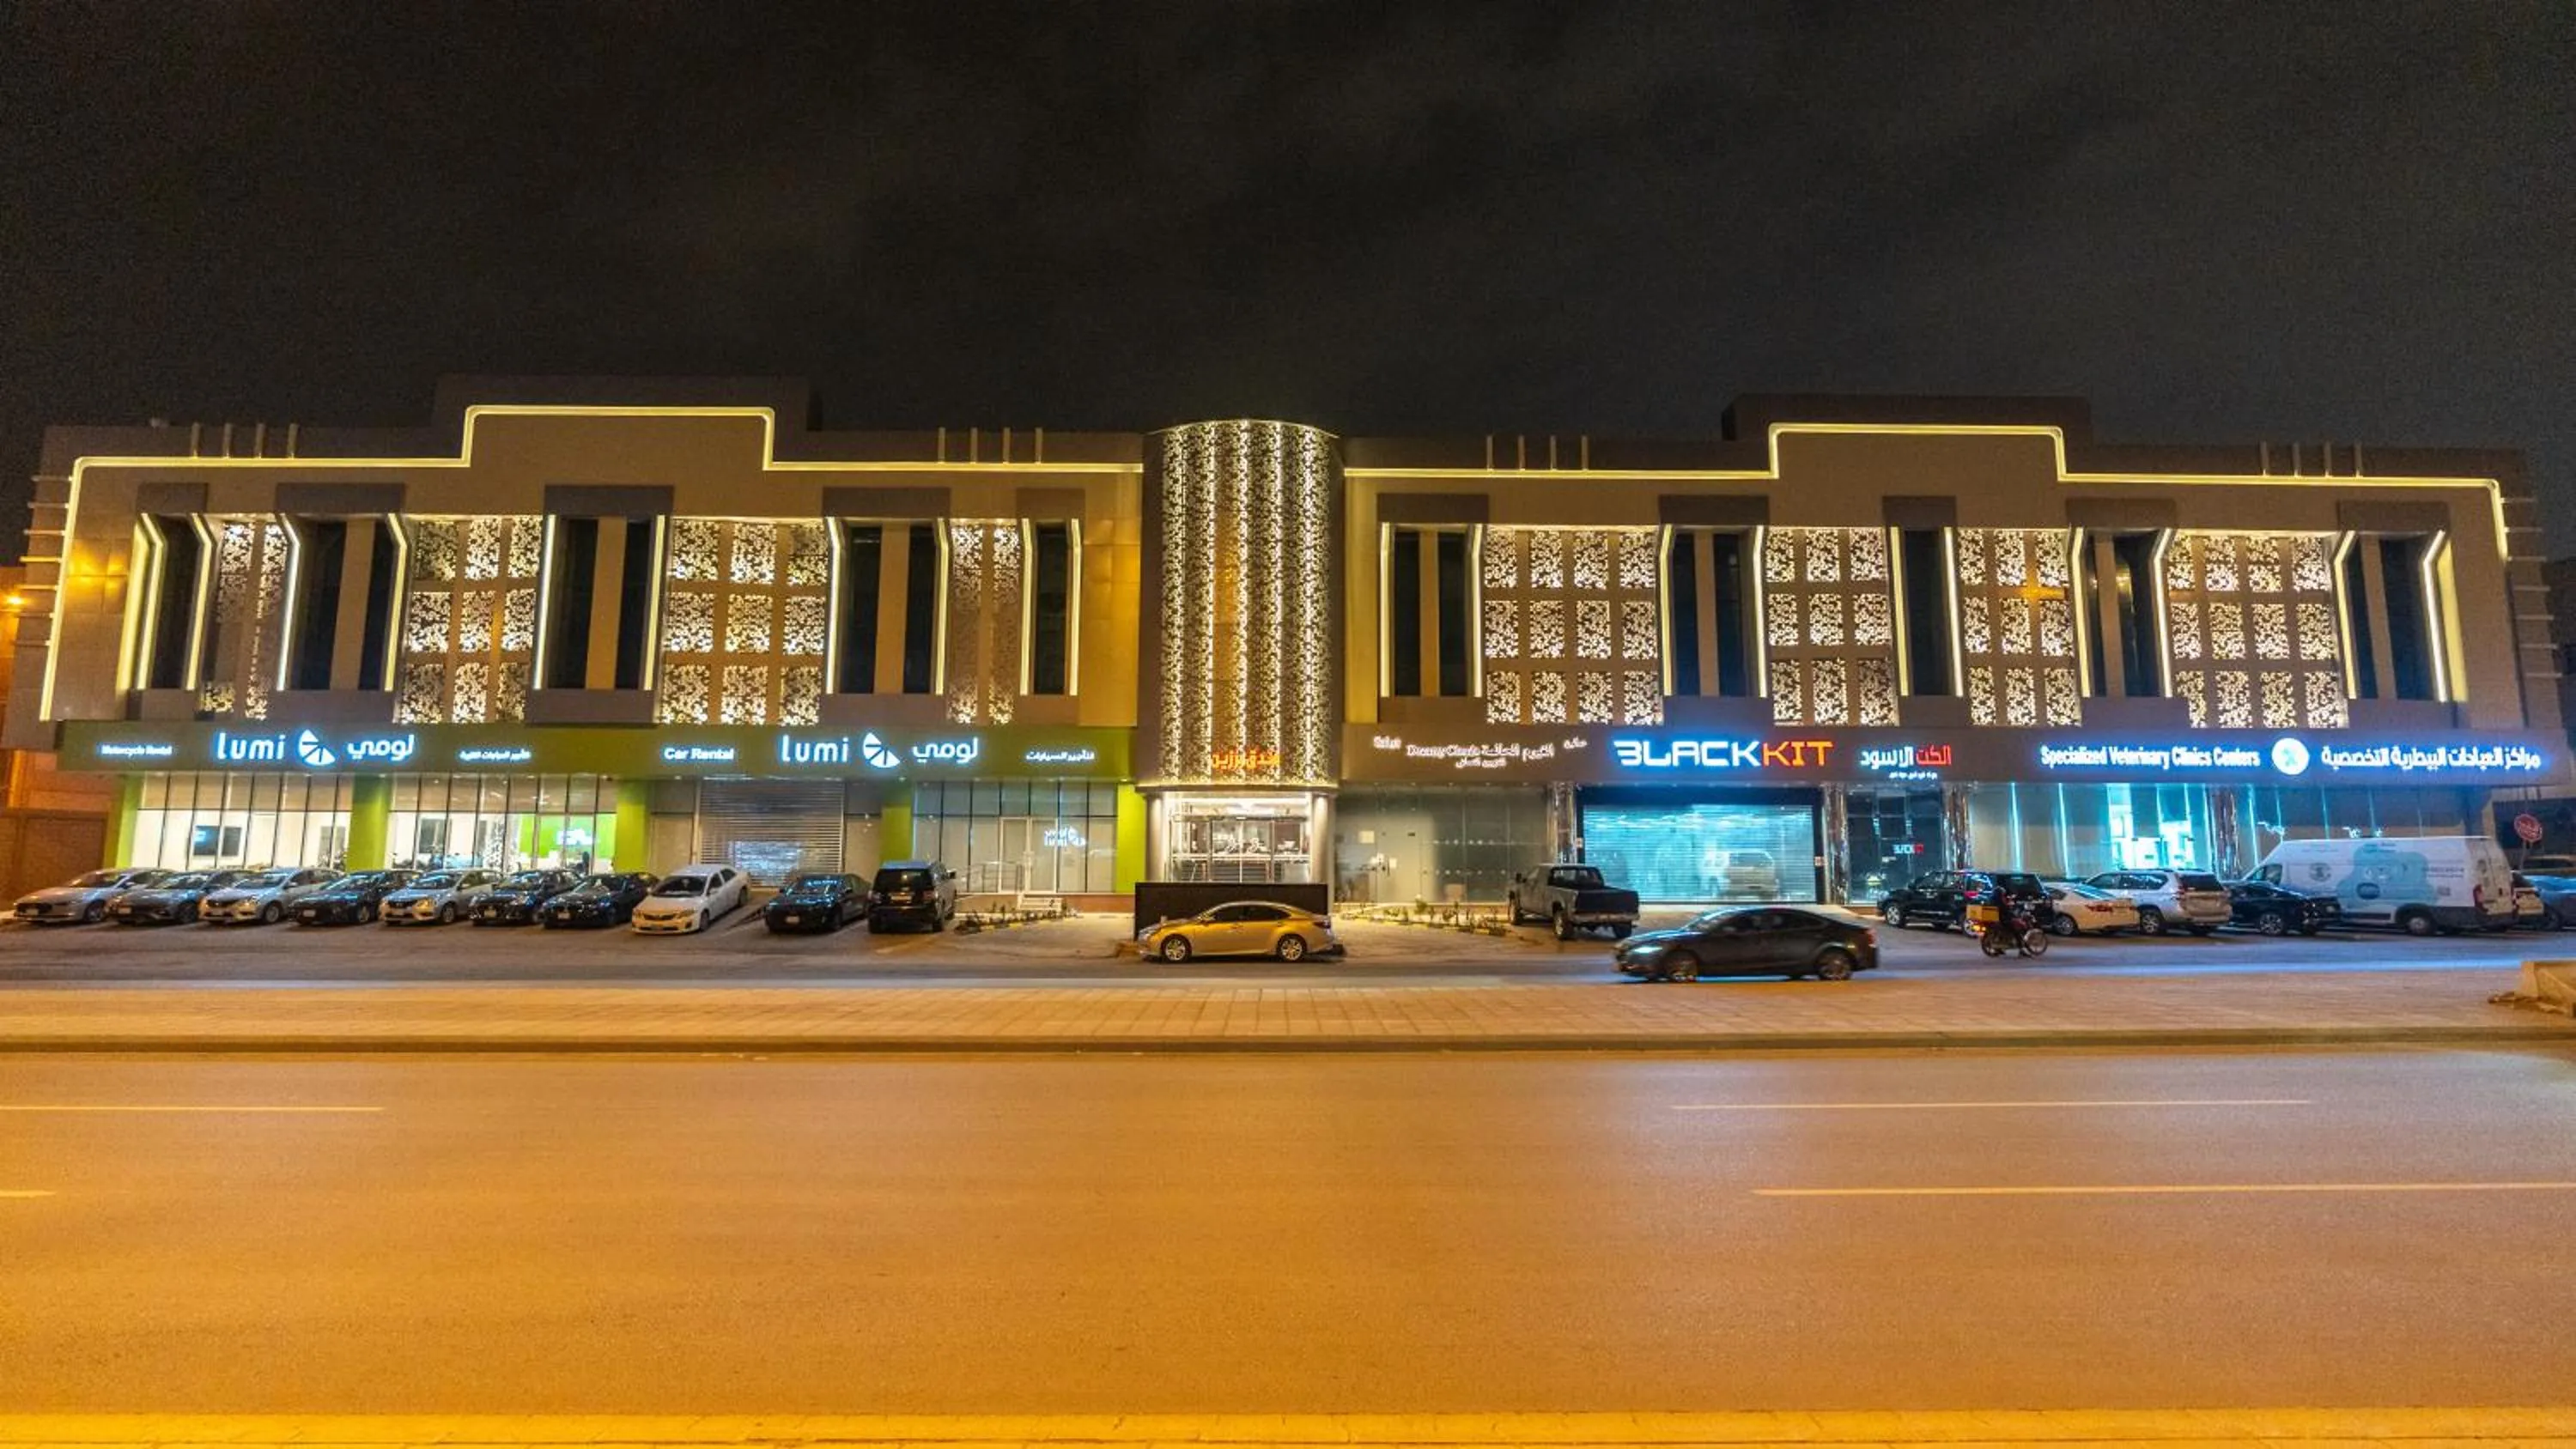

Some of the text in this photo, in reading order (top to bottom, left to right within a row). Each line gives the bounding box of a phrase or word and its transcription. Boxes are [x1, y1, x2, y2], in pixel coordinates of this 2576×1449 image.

[217, 732, 286, 760] lumi
[347, 733, 415, 761] لومي
[664, 747, 734, 760] Car Rental
[781, 734, 849, 763] lumi
[912, 736, 979, 764] لومي
[1916, 744, 1952, 766] الكت
[2040, 745, 2261, 770] Specialized Veterinary Clinics Centers
[2321, 745, 2390, 770] التخصصية
[2391, 745, 2446, 770] البيطرية
[2505, 745, 2541, 770] مراكز
